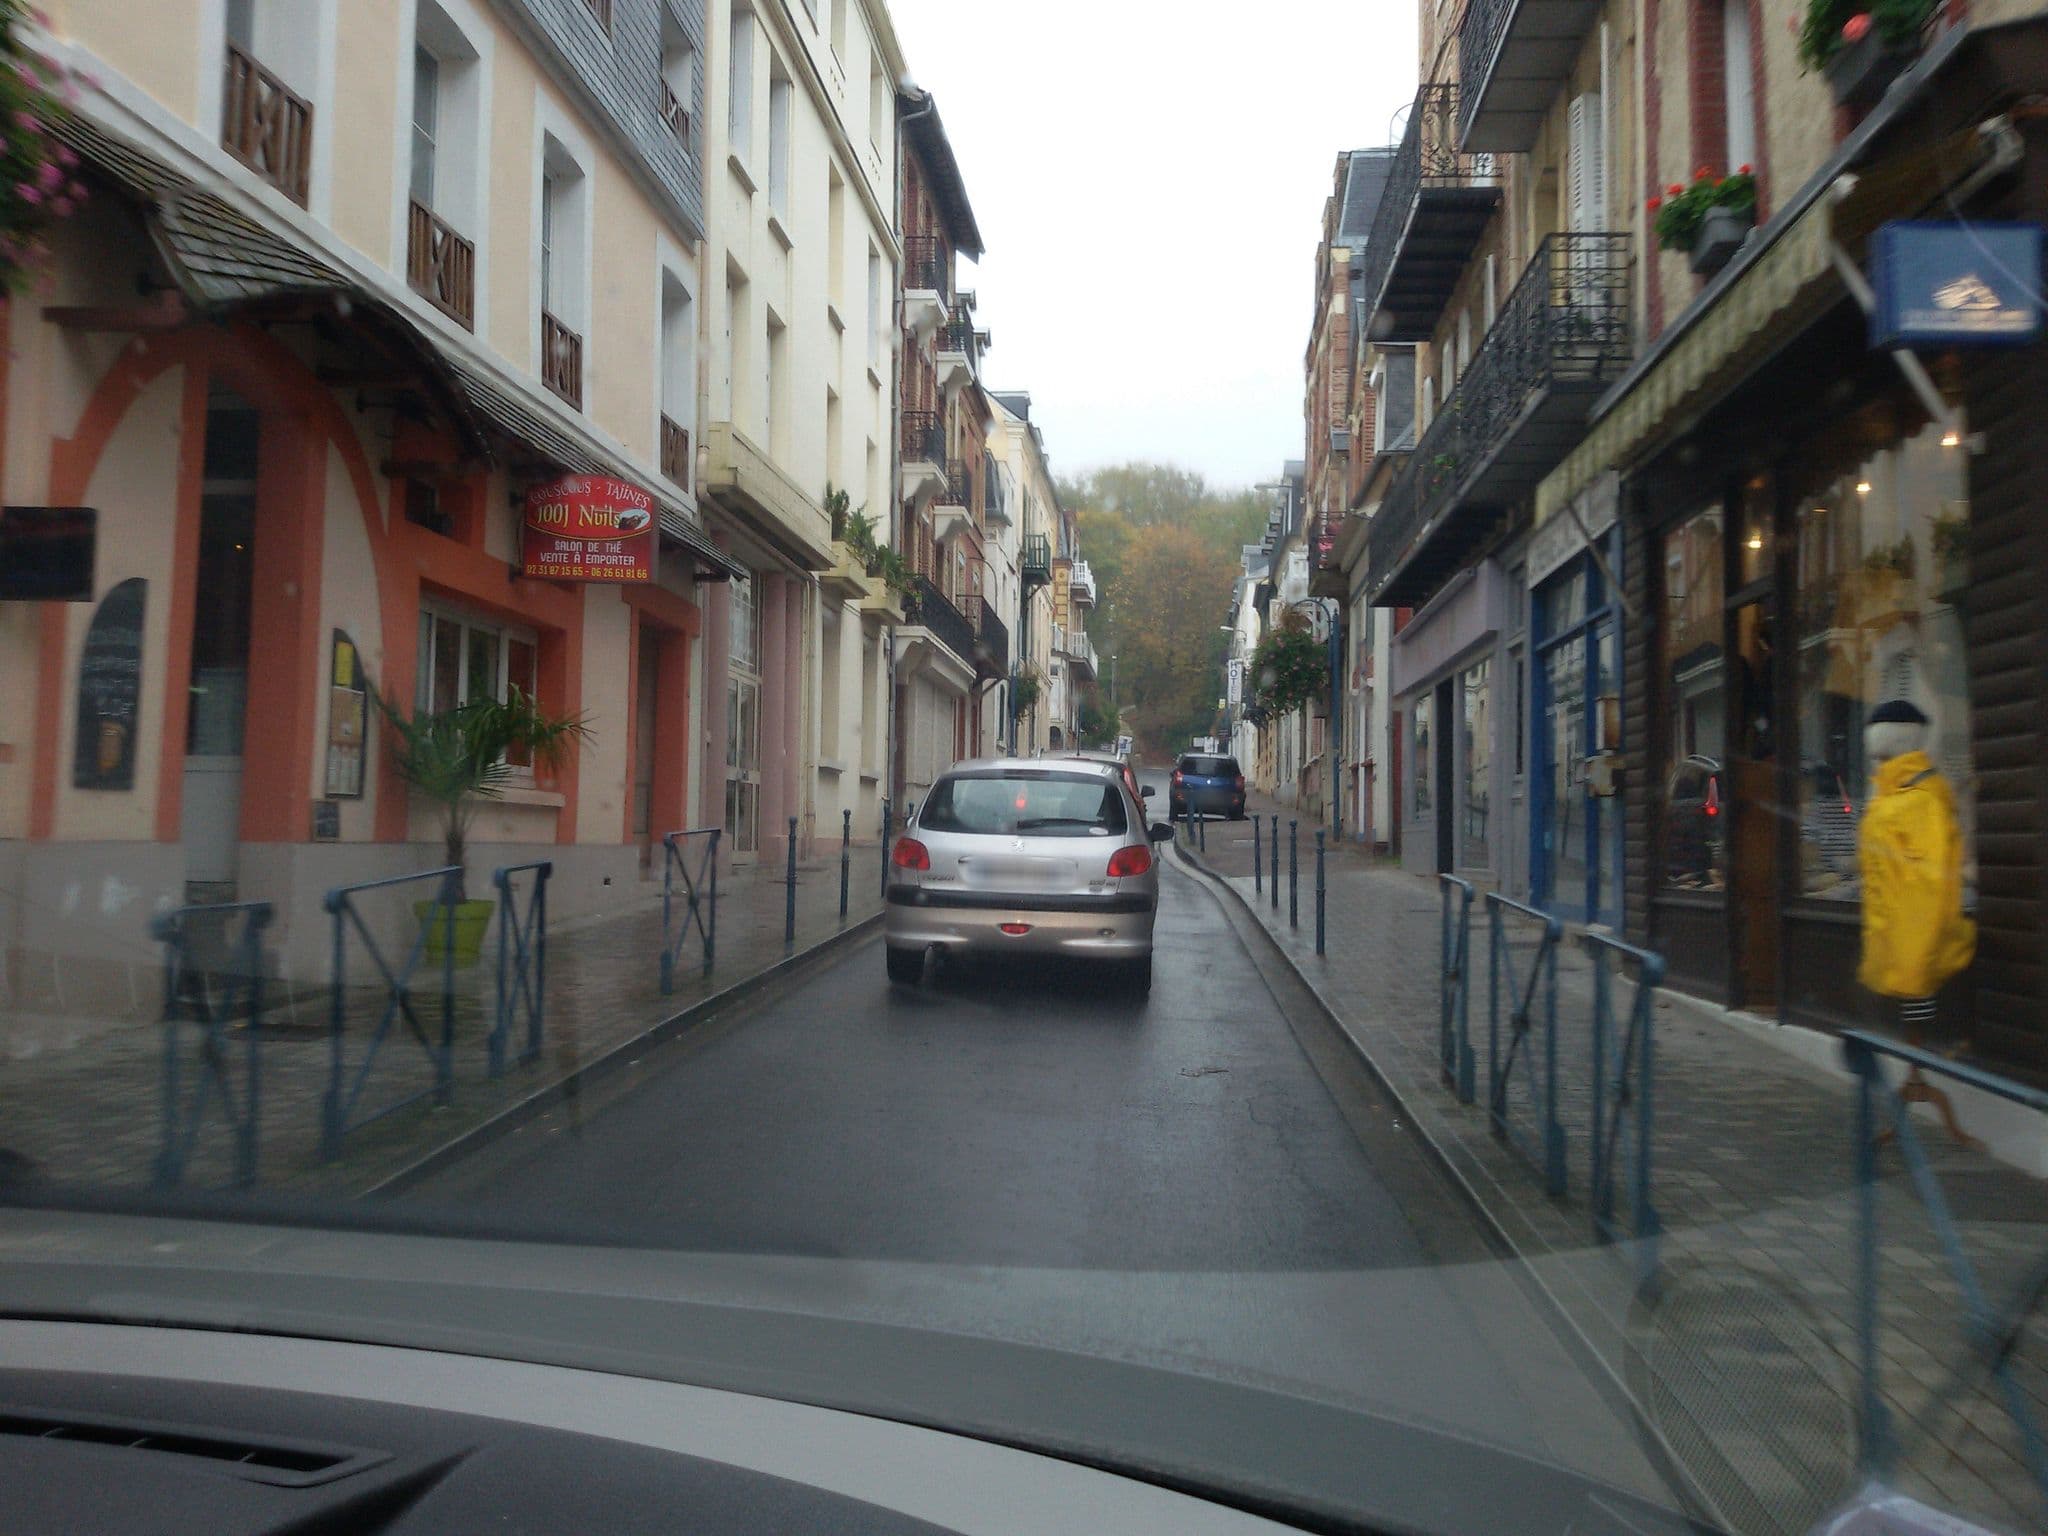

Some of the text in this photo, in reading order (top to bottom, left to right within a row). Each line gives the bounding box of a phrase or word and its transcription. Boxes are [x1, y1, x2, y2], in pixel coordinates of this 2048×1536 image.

[537, 503, 620, 528] 1001 Nuits
[554, 540, 622, 554] SALON DE THÉ
[540, 551, 635, 566] VENTE À EMPORTER
[615, 568, 624, 578] 61
[1230, 661, 1239, 702] HOTEL
